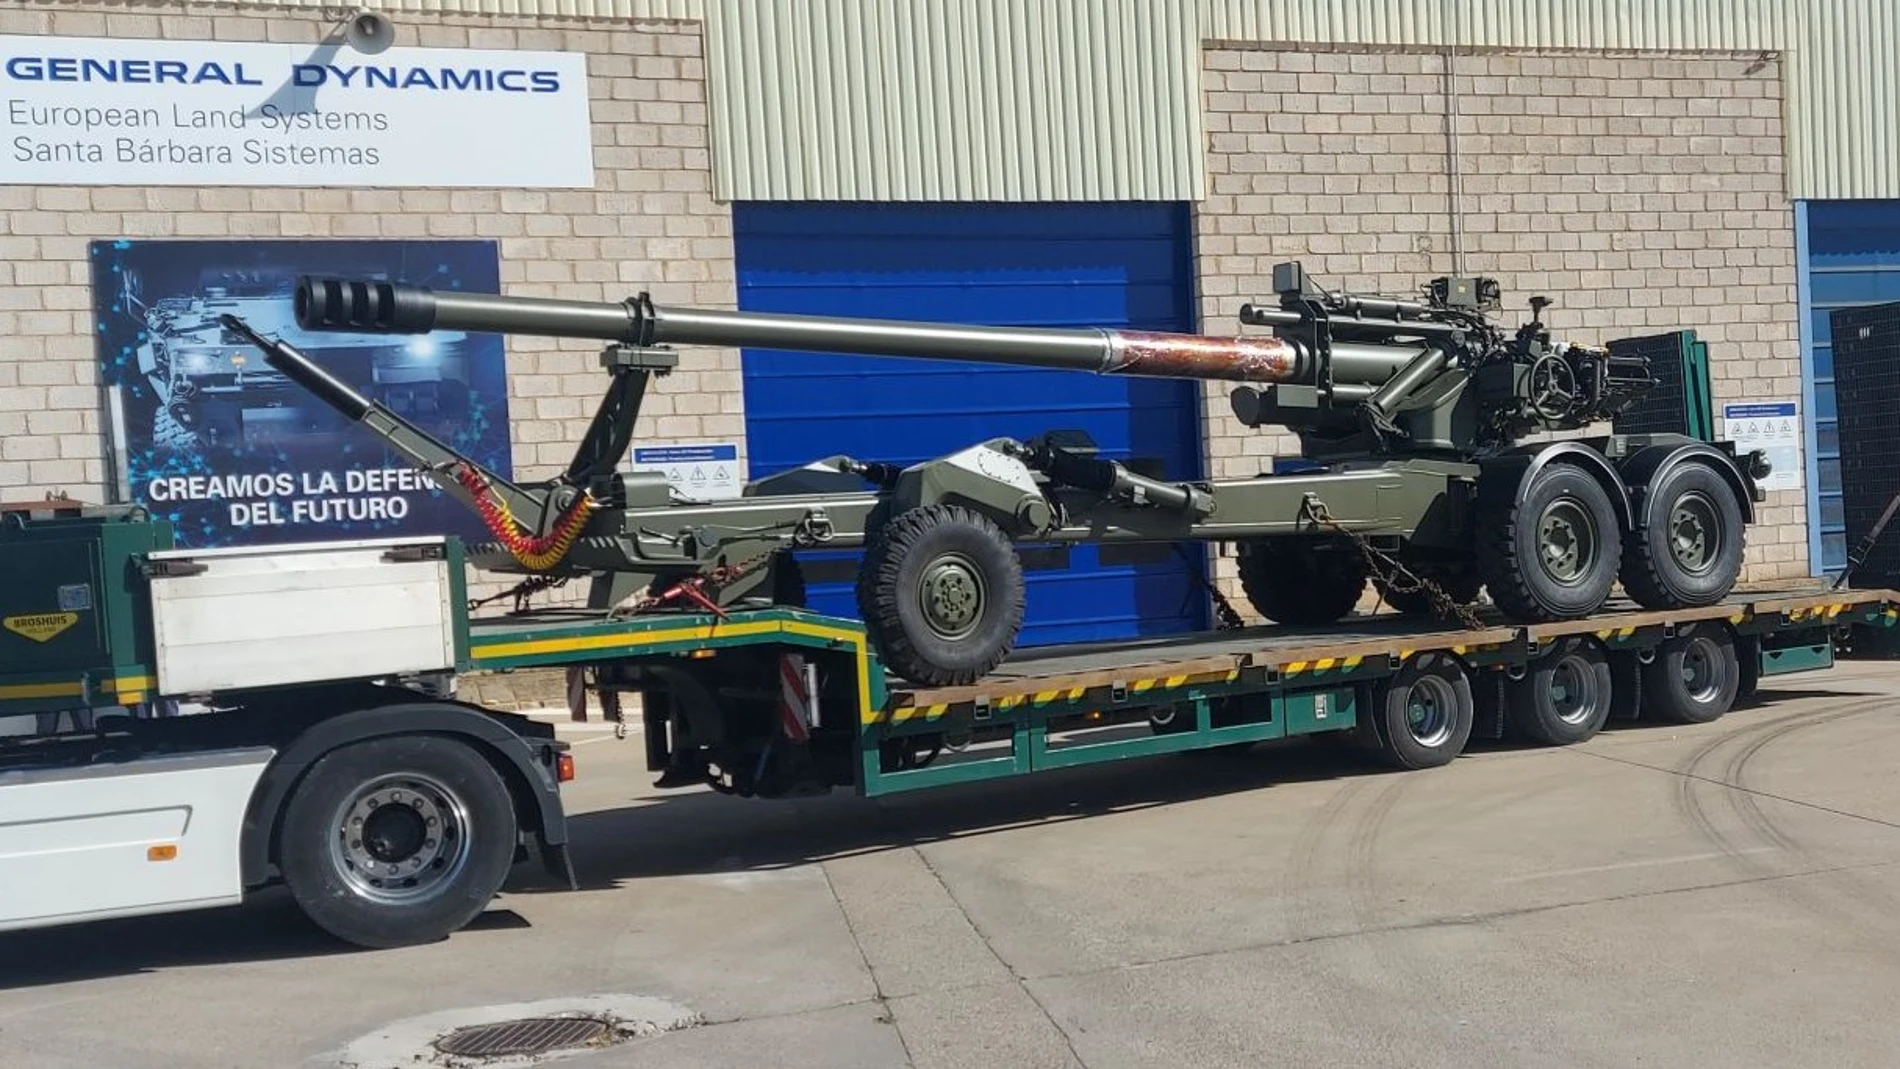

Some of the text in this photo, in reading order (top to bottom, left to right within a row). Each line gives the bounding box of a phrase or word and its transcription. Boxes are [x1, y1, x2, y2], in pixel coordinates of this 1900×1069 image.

[6, 57, 560, 93] GENERAL DYNAMICS
[9, 99, 388, 135] European Land Systems
[13, 135, 380, 165] Santa Bárbara Sistemas
[149, 472, 296, 501] CREAMOS
[302, 471, 339, 495] LA
[229, 496, 408, 526] DEL FUTURO
